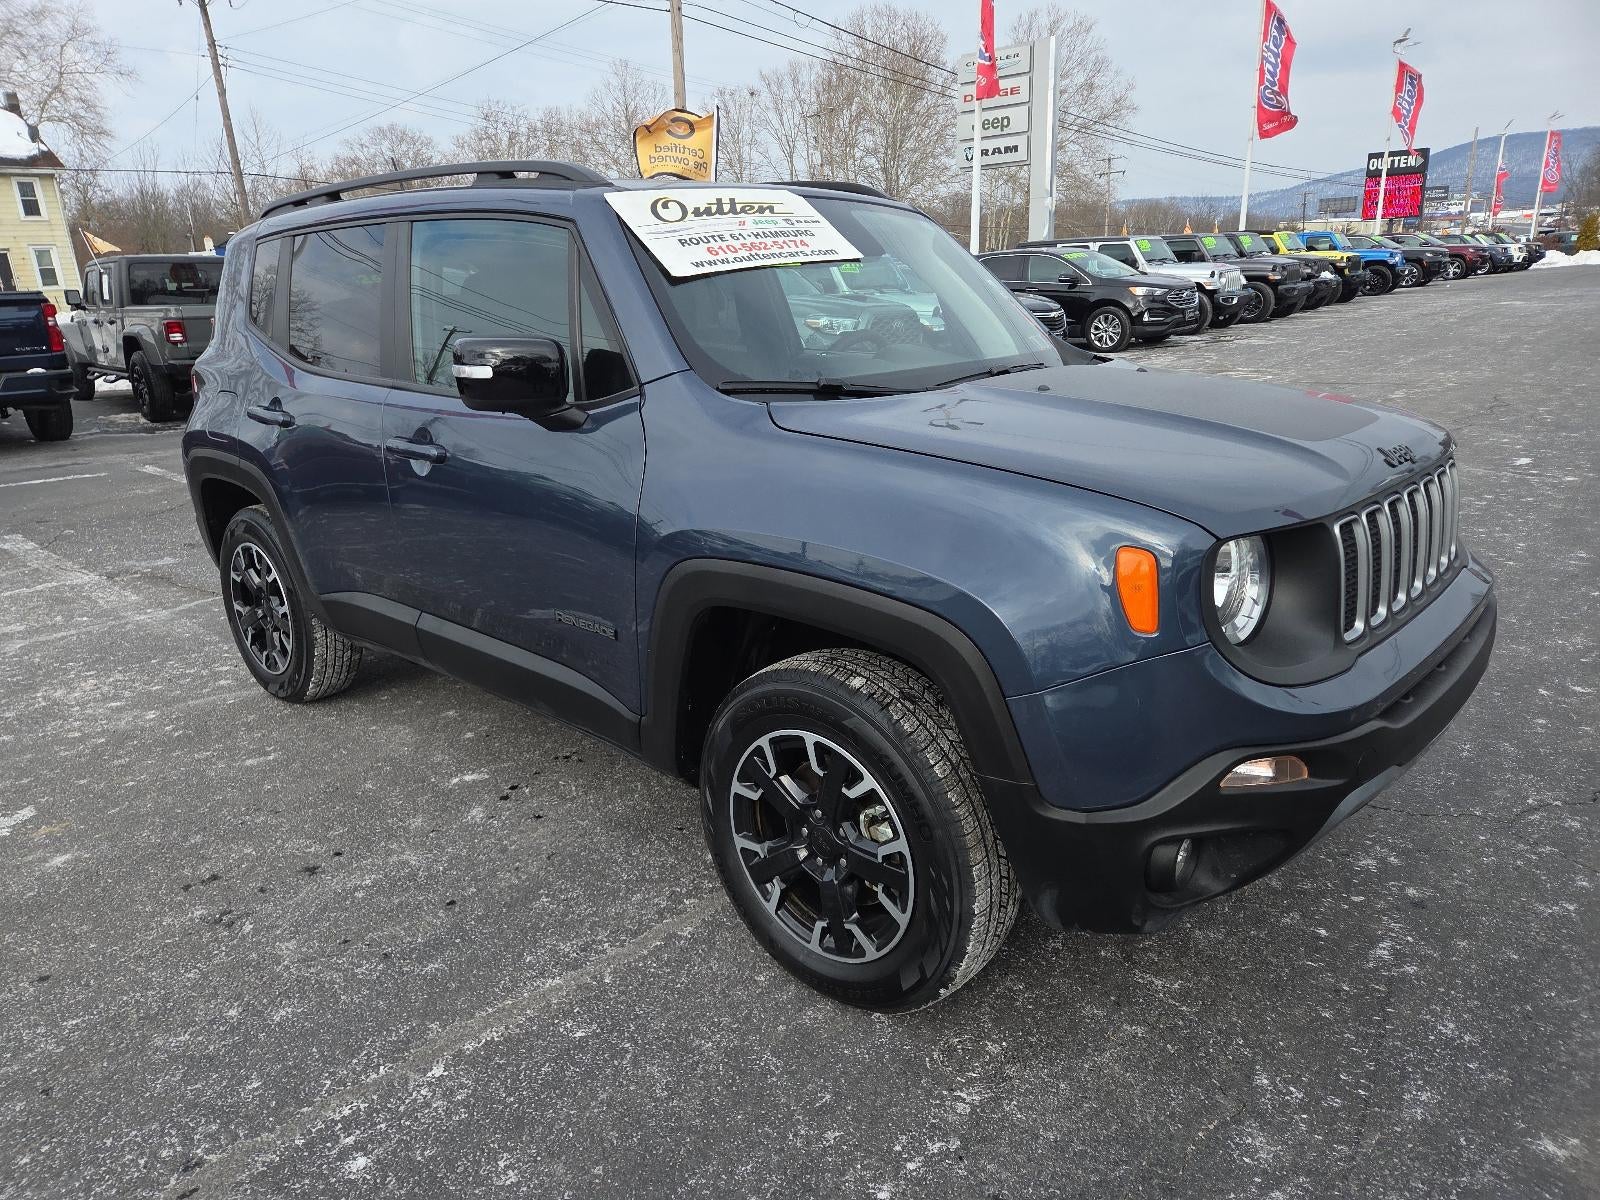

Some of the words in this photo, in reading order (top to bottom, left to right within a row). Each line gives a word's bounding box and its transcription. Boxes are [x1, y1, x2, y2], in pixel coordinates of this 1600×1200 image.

[963, 86, 1021, 103] DGE
[972, 115, 1011, 132] eep
[981, 144, 1019, 157] RAM
[650, 196, 795, 224] Outten
[677, 233, 730, 248] ROUTE
[689, 247, 839, 269] www.outtencars.com
[553, 608, 618, 641] RENEGADE
